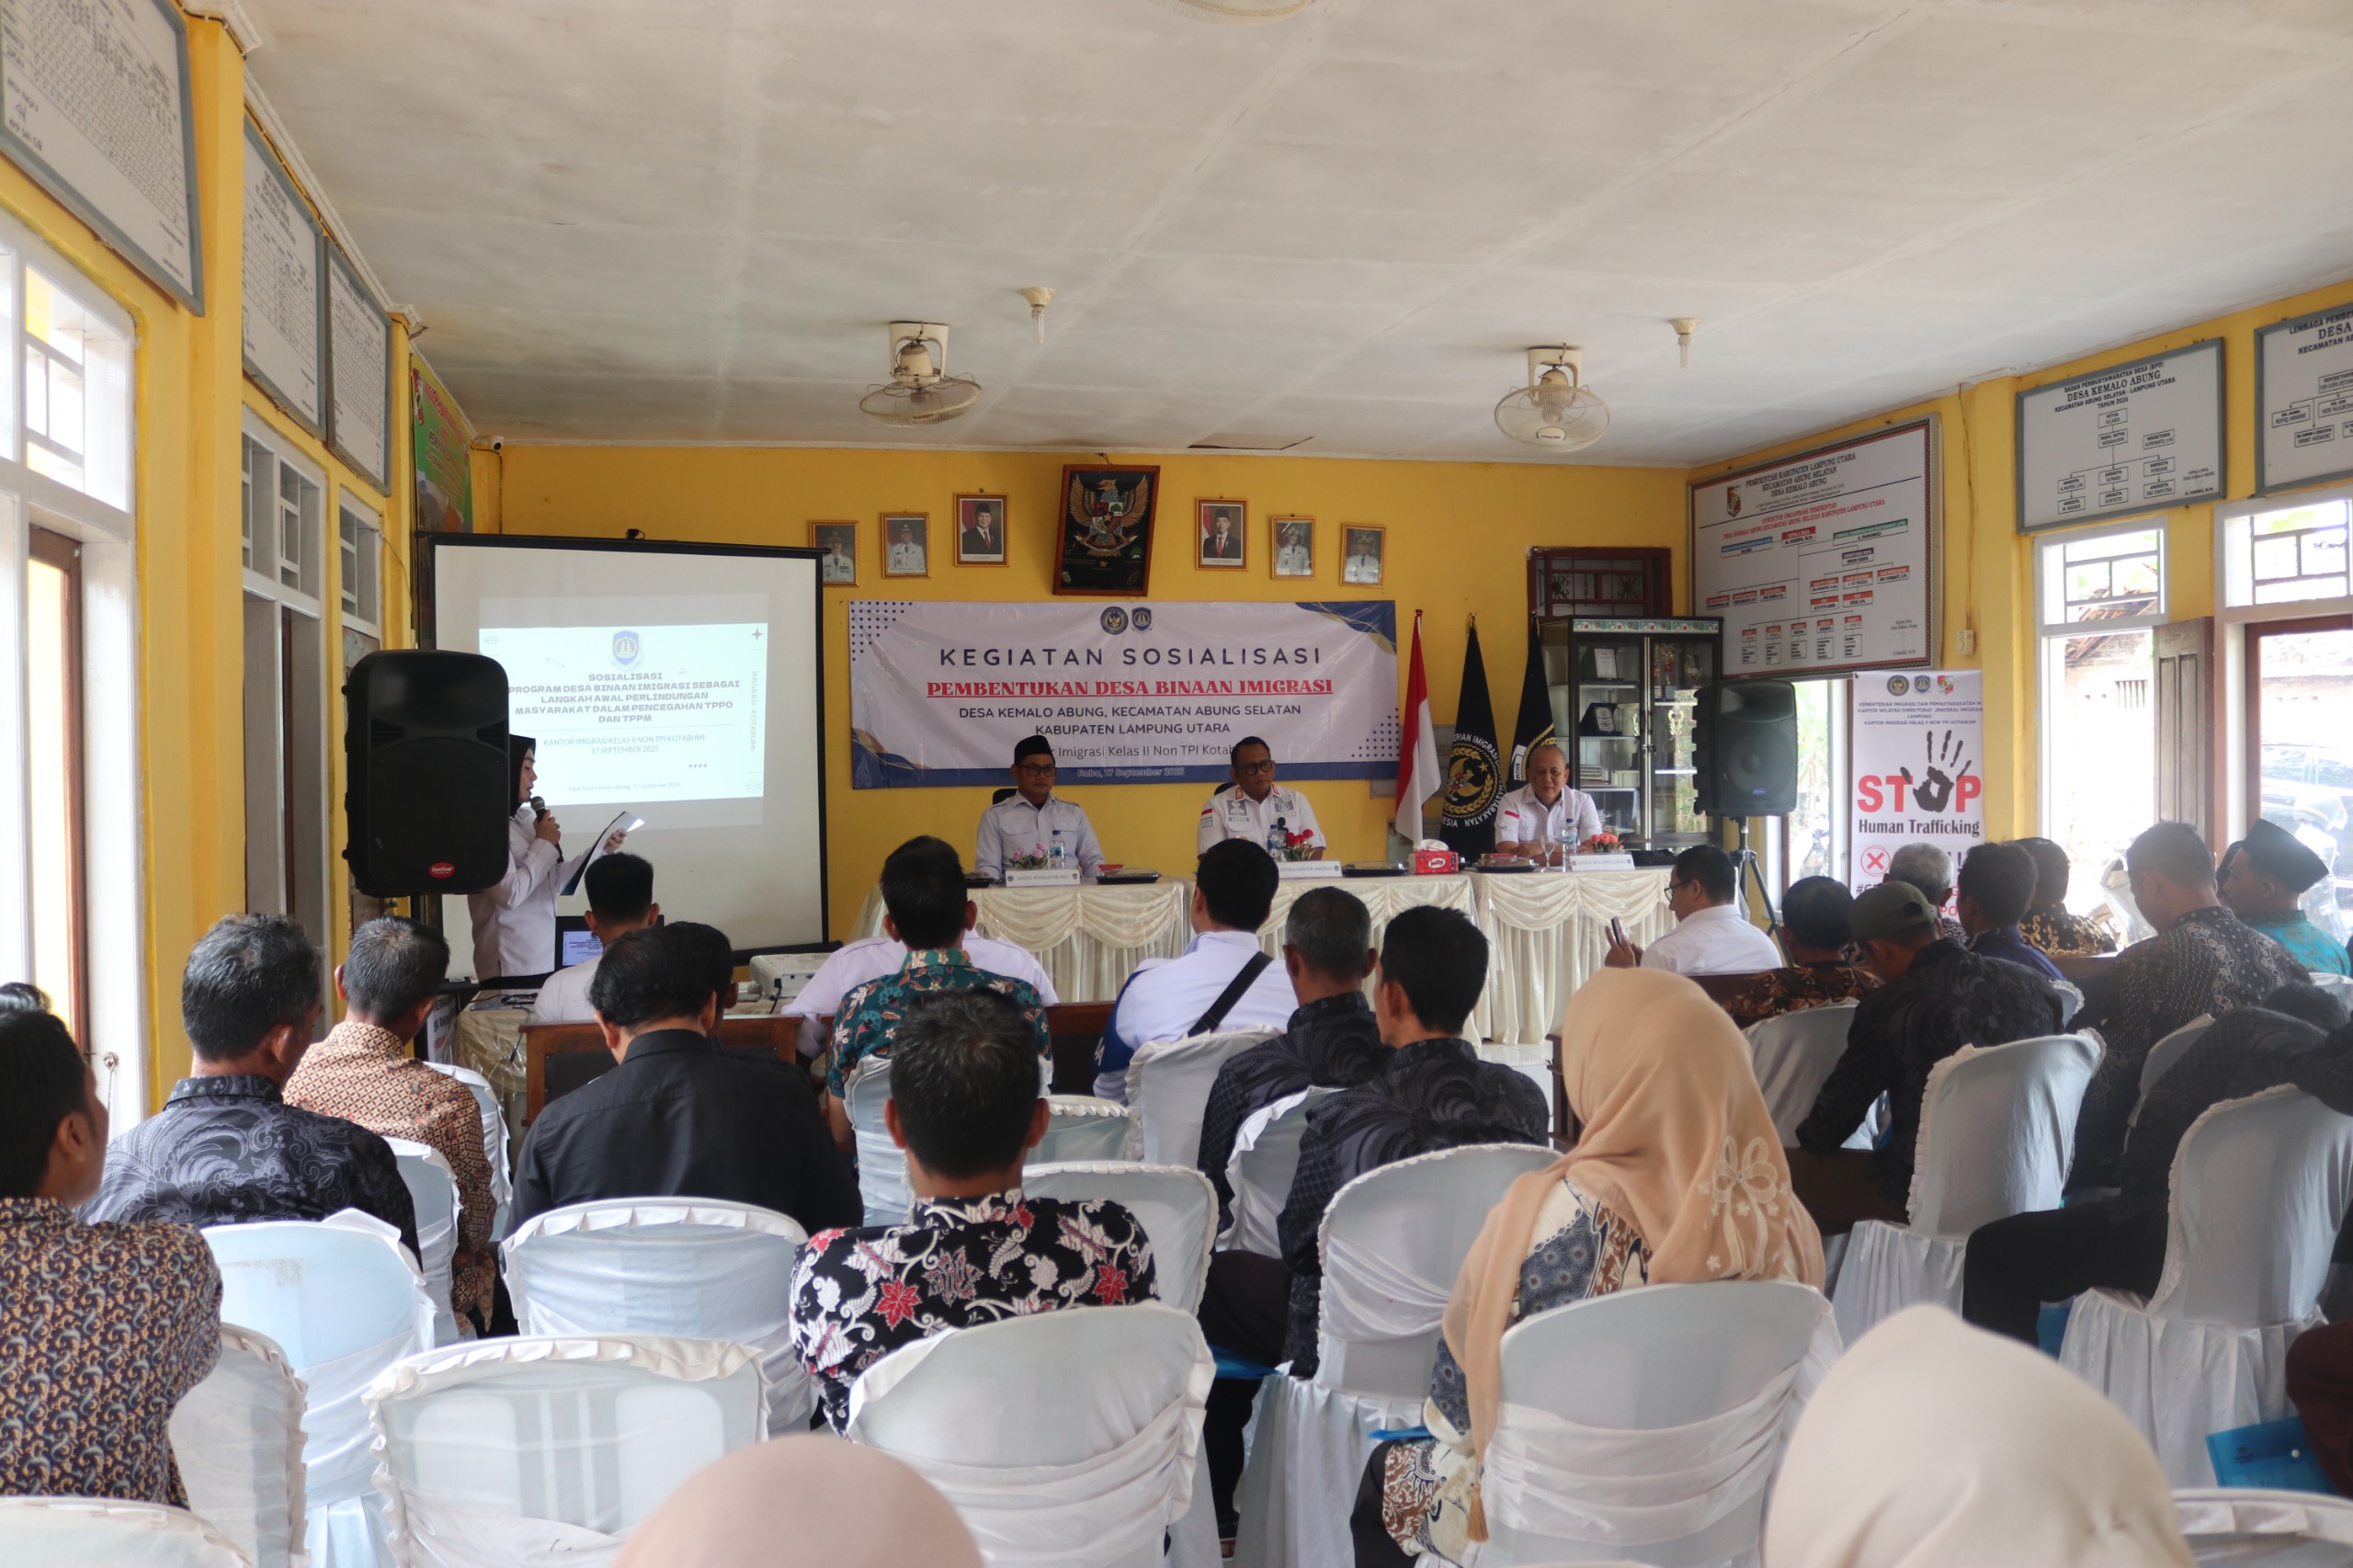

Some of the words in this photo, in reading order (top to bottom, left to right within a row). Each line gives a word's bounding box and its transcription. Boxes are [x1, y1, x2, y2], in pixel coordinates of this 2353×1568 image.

[2318, 322, 2352, 339] DESA
[2298, 336, 2343, 355] KECAMATAN
[2064, 384, 2081, 393] BADAN
[2133, 365, 2148, 375] DESA
[2067, 390, 2089, 403] DESA
[2091, 379, 2128, 396] KEMALO
[2130, 370, 2161, 386] ABUNG
[2054, 401, 2084, 413] KECAMATAN
[2085, 396, 2102, 405] ABUNG
[2103, 391, 2126, 401] SELATAN
[2130, 383, 2156, 394] LAMPUNG
[2157, 377, 2176, 387] UTARA
[2097, 401, 2115, 409] TAHUN
[1746, 472, 1779, 488] PEMERINTAH
[1779, 465, 1809, 479] KABUPATEN
[1810, 458, 1836, 472] LAMPUNG
[1837, 452, 1857, 463] UTARA
[1762, 478, 1793, 492] KECAMATAN
[1794, 472, 1812, 483] ABUNG
[1813, 466, 1837, 478] SELATAN
[1771, 489, 1785, 497] DESA
[1785, 483, 1808, 494] KEMALO
[1808, 478, 1827, 488] ABUNG
[940, 649, 1102, 665] KEGIATAN
[1122, 648, 1320, 665] SOSIALISASI
[588, 672, 663, 682] SOSIALISASI
[508, 686, 562, 694] PROGRAM
[594, 683, 636, 692] BINAAN
[638, 682, 691, 690] IMIGRASI
[692, 680, 741, 689] SEBAGAI
[927, 681, 1088, 696] PEMBENTUKAN
[1096, 680, 1149, 695] DESA
[1155, 679, 1233, 694] BINAAN
[1239, 678, 1333, 693] IMIGRASI
[540, 695, 593, 704] LANGKAH
[594, 694, 624, 702] AWAL
[625, 692, 709, 701] PERLINDUNGAN
[515, 705, 591, 715] MASYARAKAT
[592, 704, 631, 712] DALAM
[631, 702, 703, 711] PENCEGAHAN
[704, 701, 733, 710] TPPO
[960, 708, 995, 719] DESA
[998, 707, 1053, 718] KEMALO
[1057, 706, 1108, 718] ABUNG,
[1111, 706, 1191, 717] KECAMATAN
[1195, 705, 1241, 716] ABUNG
[1244, 705, 1302, 715] SELATAN
[598, 715, 620, 723] DAN
[622, 714, 653, 723] TPPM
[1035, 724, 1115, 735] KABUPATEN
[1119, 723, 1183, 734] LAMPUNG
[1187, 722, 1231, 733] UTARA
[543, 738, 574, 746] KANTOR
[574, 737, 608, 745] IMIGRASI
[608, 736, 631, 744] KELAS
[666, 734, 705, 743] KOTABUMI
[1472, 734, 1499, 760] IMIGRASI
[591, 746, 599, 755] 17
[600, 745, 642, 754] SEPTEMBER
[642, 744, 659, 753] 2025
[1058, 745, 1105, 759] Imigrasi
[1108, 744, 1140, 756] Kelas
[1142, 744, 1150, 756] II
[1153, 744, 1177, 756] Non
[1180, 744, 1199, 756] TPI
[1202, 744, 1235, 756] Kotab
[1077, 768, 1104, 778] Rabu,
[1105, 767, 1114, 778] 17
[1115, 767, 1163, 779] September
[1164, 767, 1186, 777] 2025
[1859, 819, 1904, 834] Human
[1909, 819, 1980, 837] Trafficking
[1430, 858, 1444, 868] jolly
